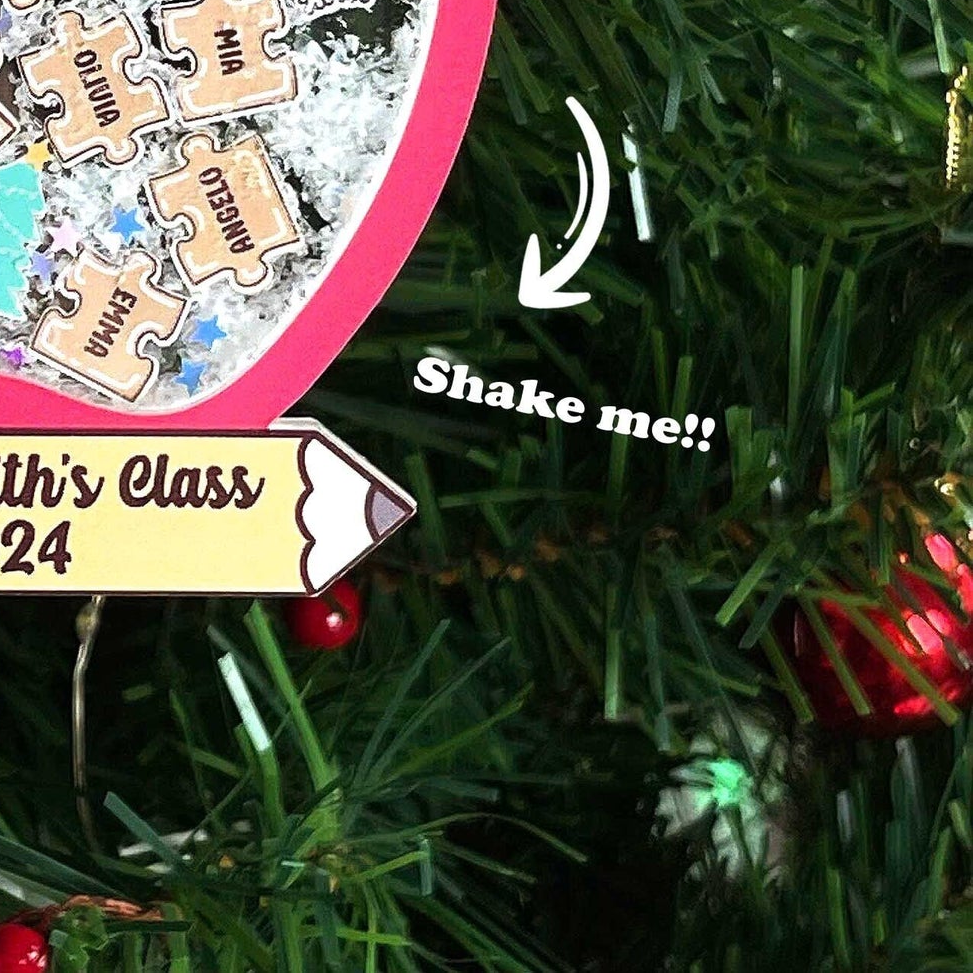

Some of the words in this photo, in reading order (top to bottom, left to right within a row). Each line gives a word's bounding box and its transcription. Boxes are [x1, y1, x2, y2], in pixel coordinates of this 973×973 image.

[73, 49, 121, 128] OLIVIA
[213, 28, 245, 76] MIA
[198, 167, 255, 254] ANGELO
[83, 286, 141, 360] EMMA
[118, 453, 266, 510] Class
